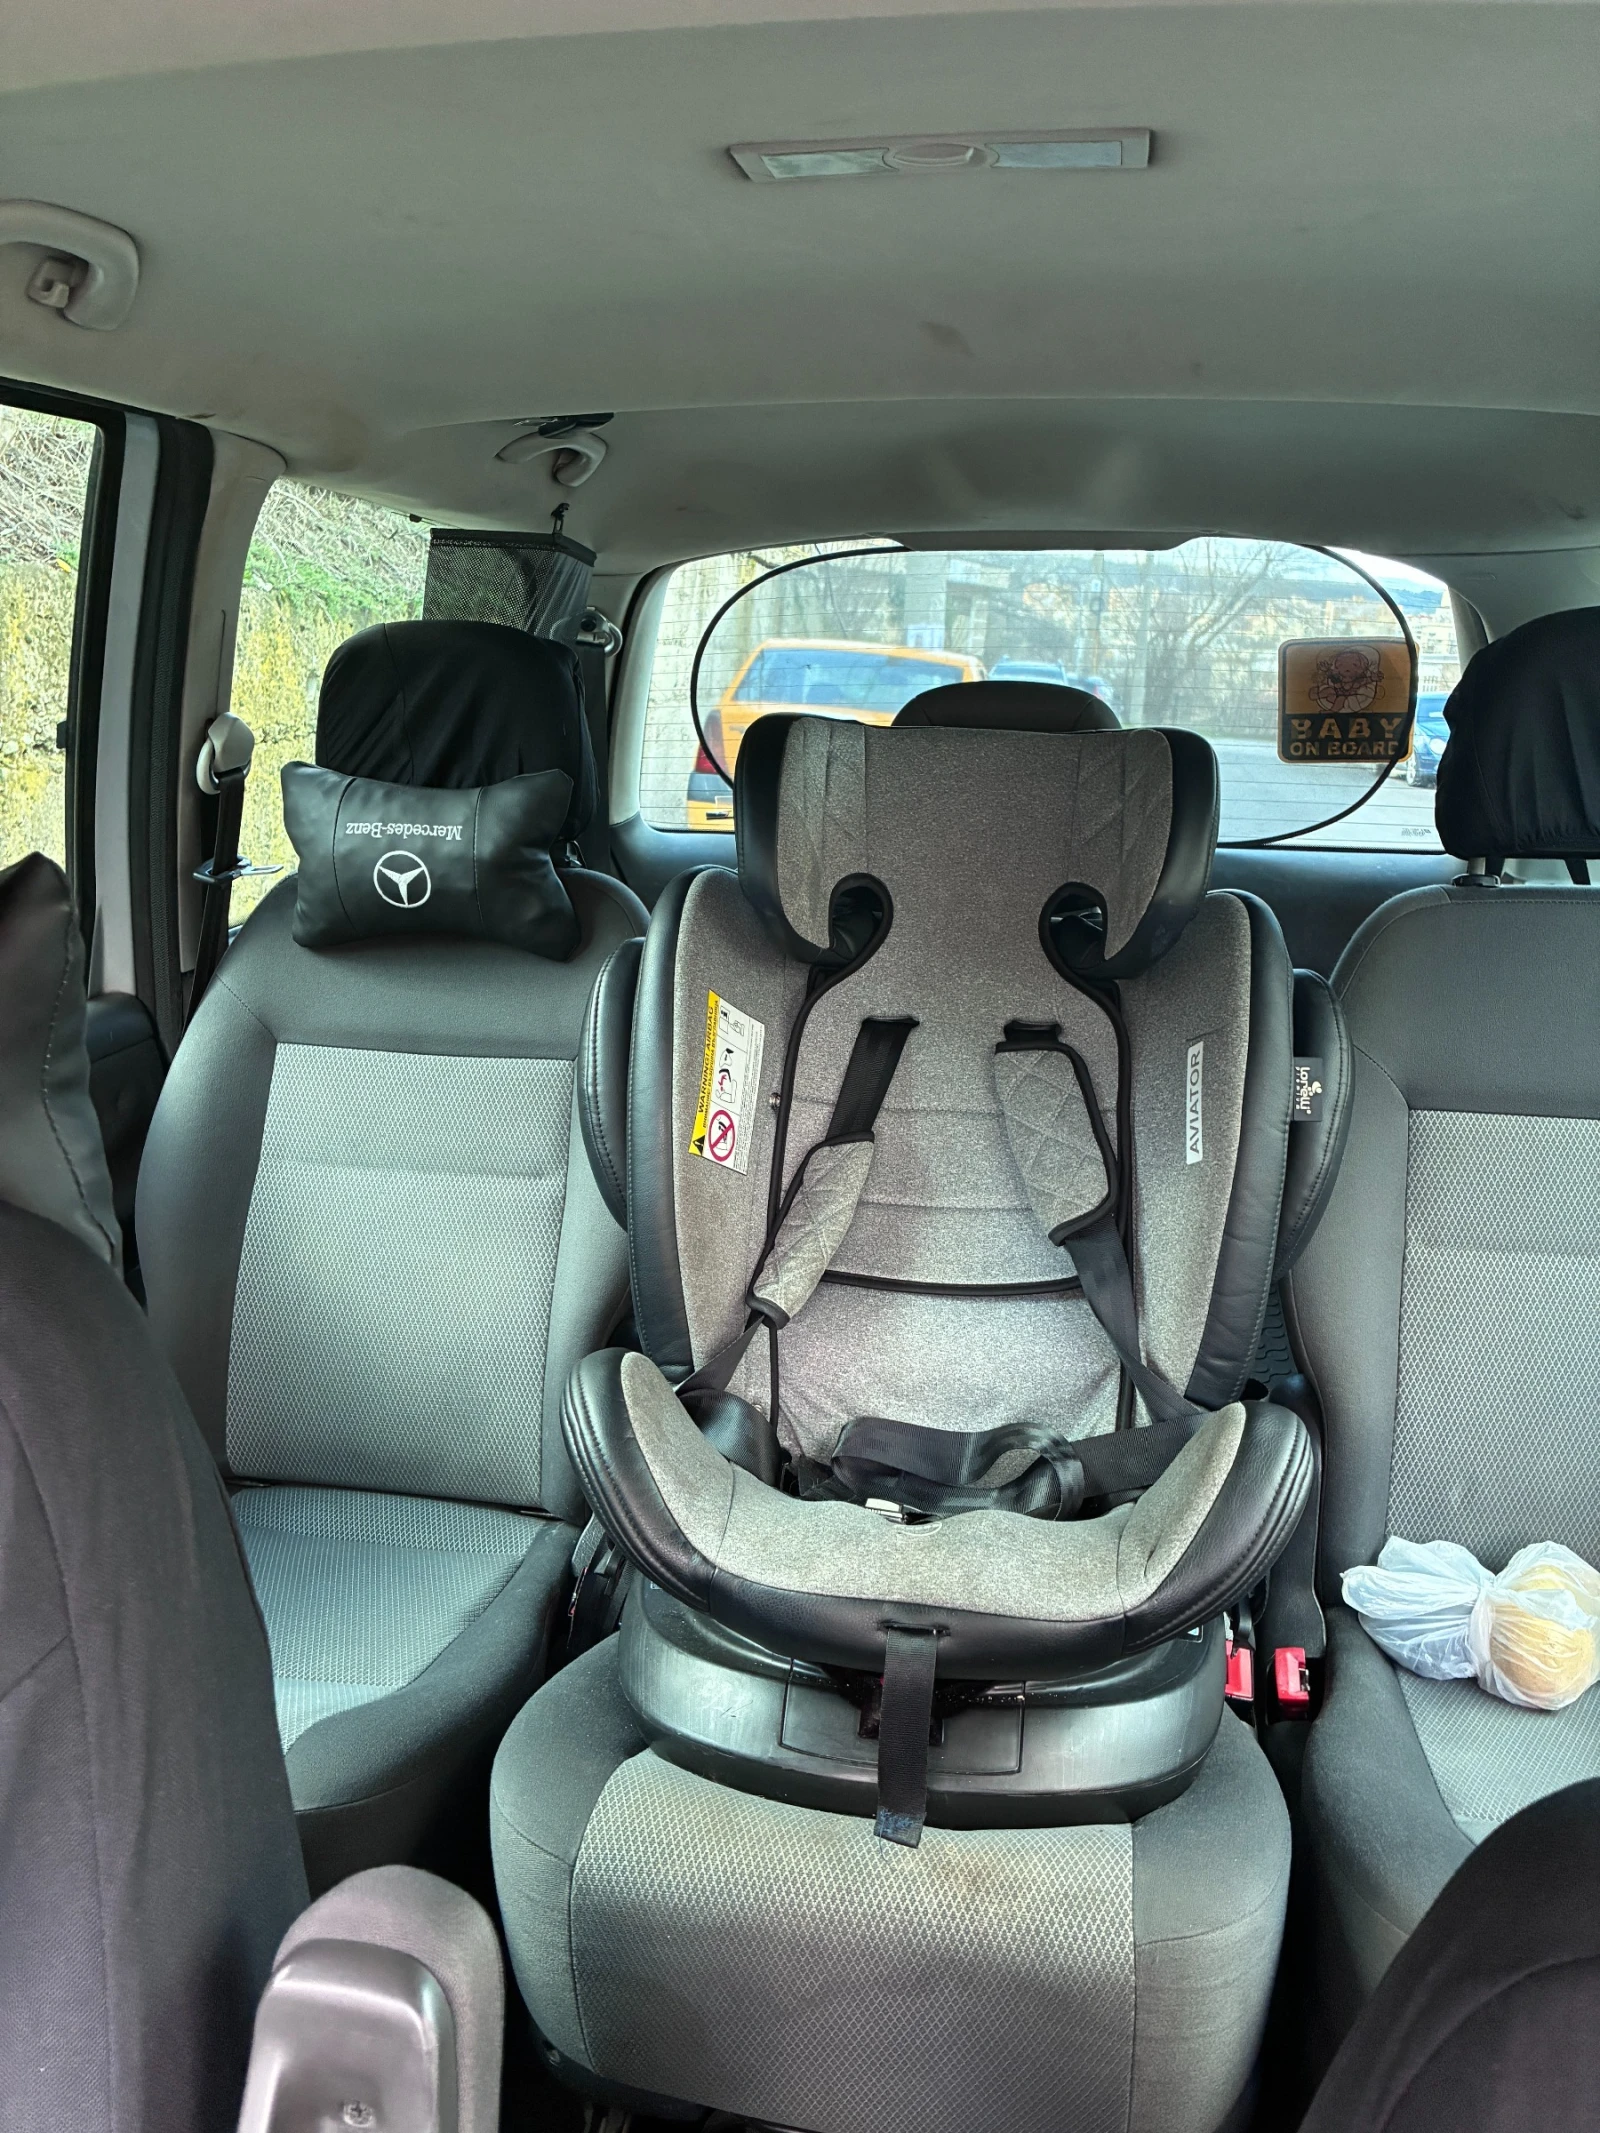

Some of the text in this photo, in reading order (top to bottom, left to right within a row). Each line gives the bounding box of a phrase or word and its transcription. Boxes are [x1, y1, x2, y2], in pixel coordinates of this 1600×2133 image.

[1290, 717, 1402, 739] BABY
[1290, 741, 1399, 756] ON BOARD
[345, 822, 463, 841] Mercedes-Benz
[698, 1006, 714, 1113] WARNING! AIRBAG
[1189, 1051, 1200, 1154] AVIATOR
